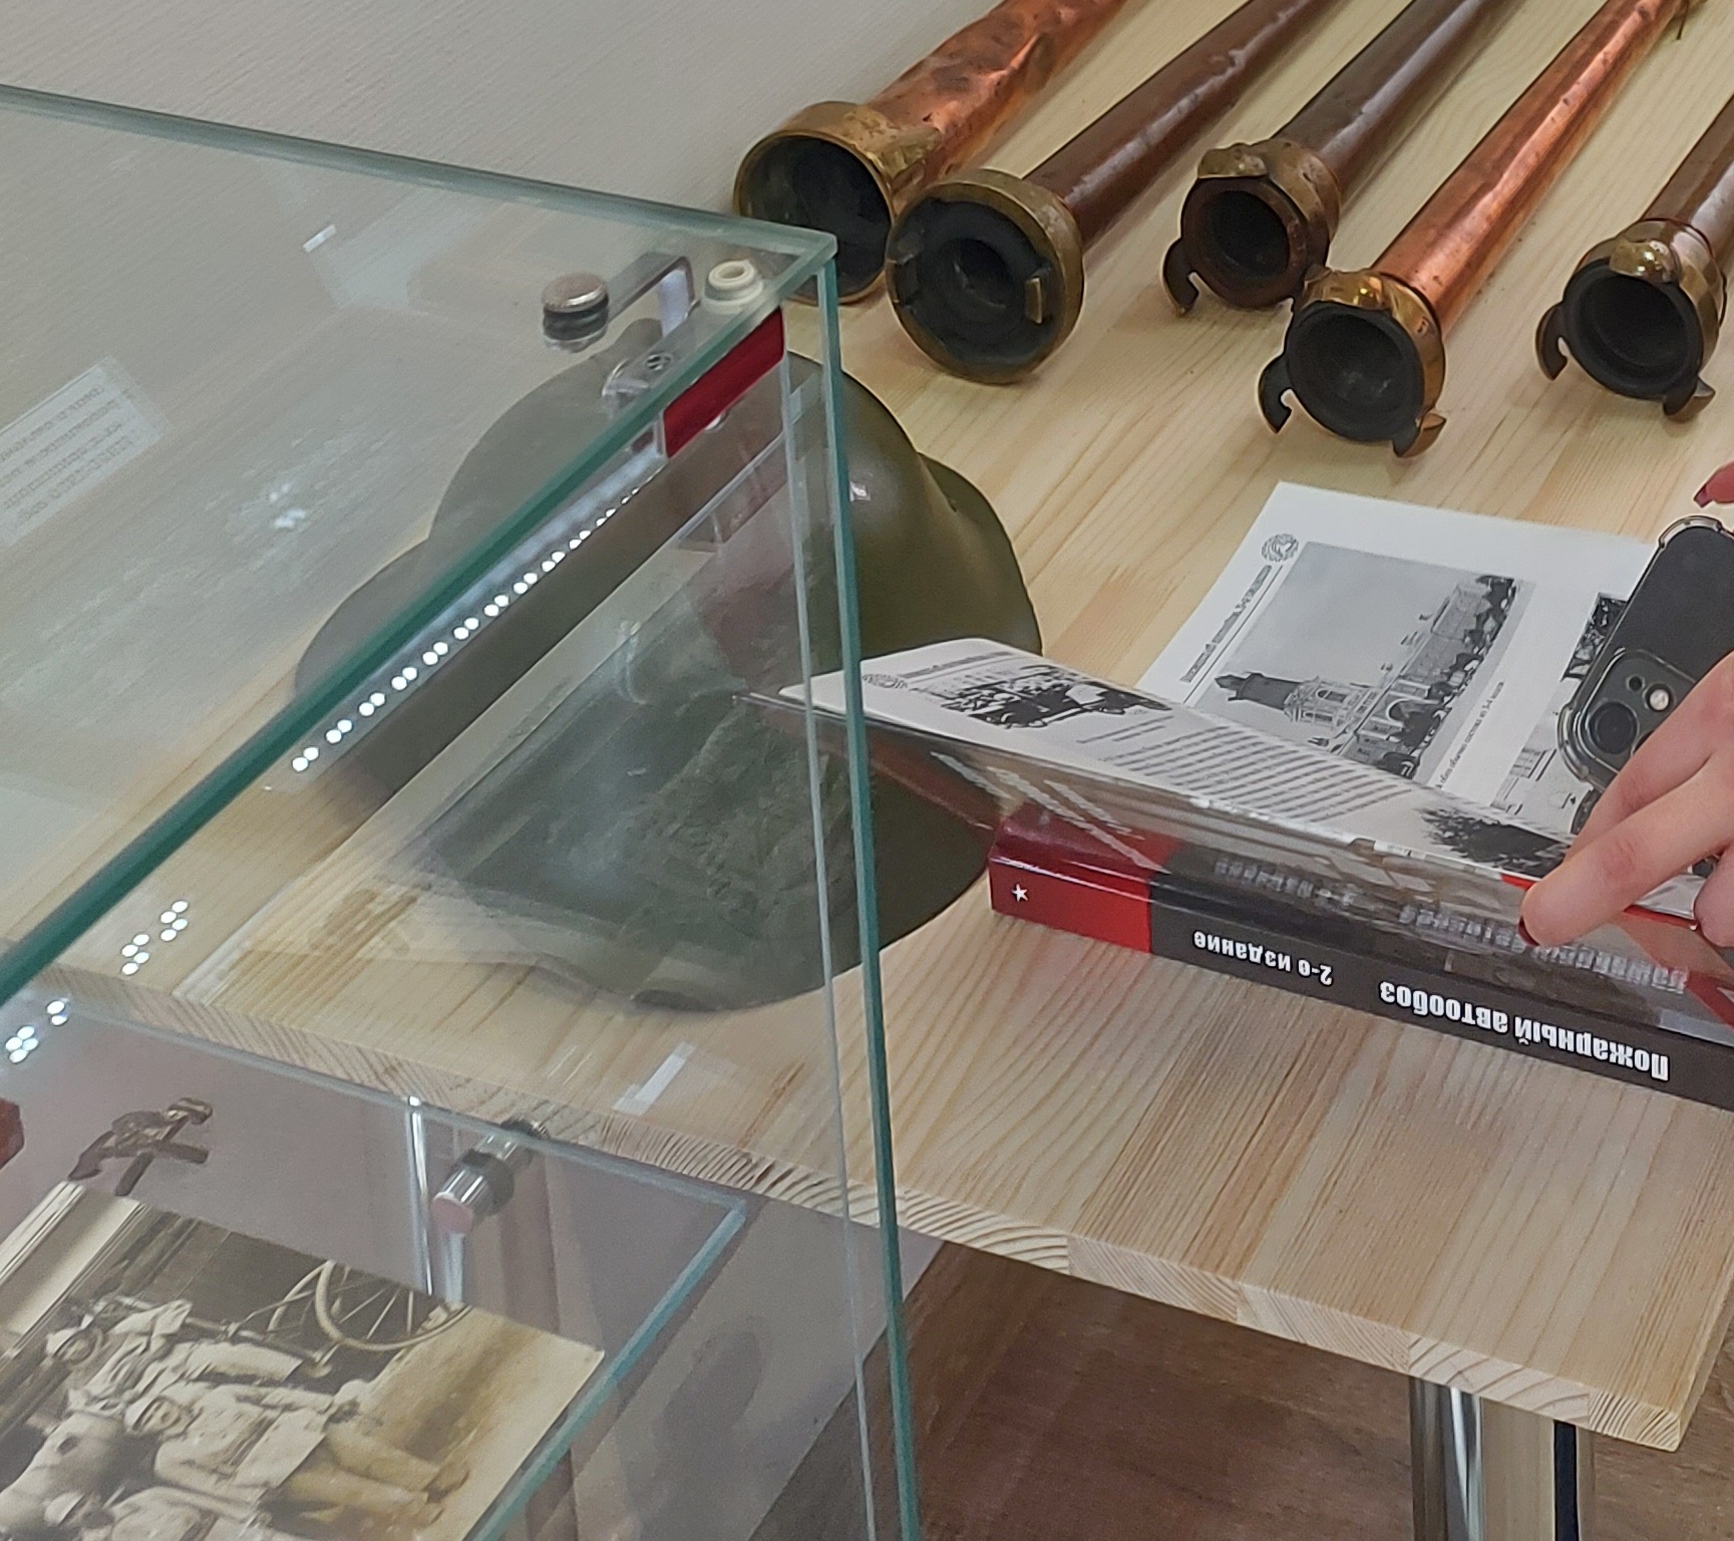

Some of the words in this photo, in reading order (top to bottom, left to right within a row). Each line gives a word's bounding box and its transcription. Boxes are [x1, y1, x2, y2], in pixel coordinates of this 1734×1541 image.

[1192, 929, 1292, 972] издание
[1299, 957, 1335, 986] 2-е
[1379, 980, 1508, 1034] автообоз
[1514, 1014, 1669, 1082] Пожарный
